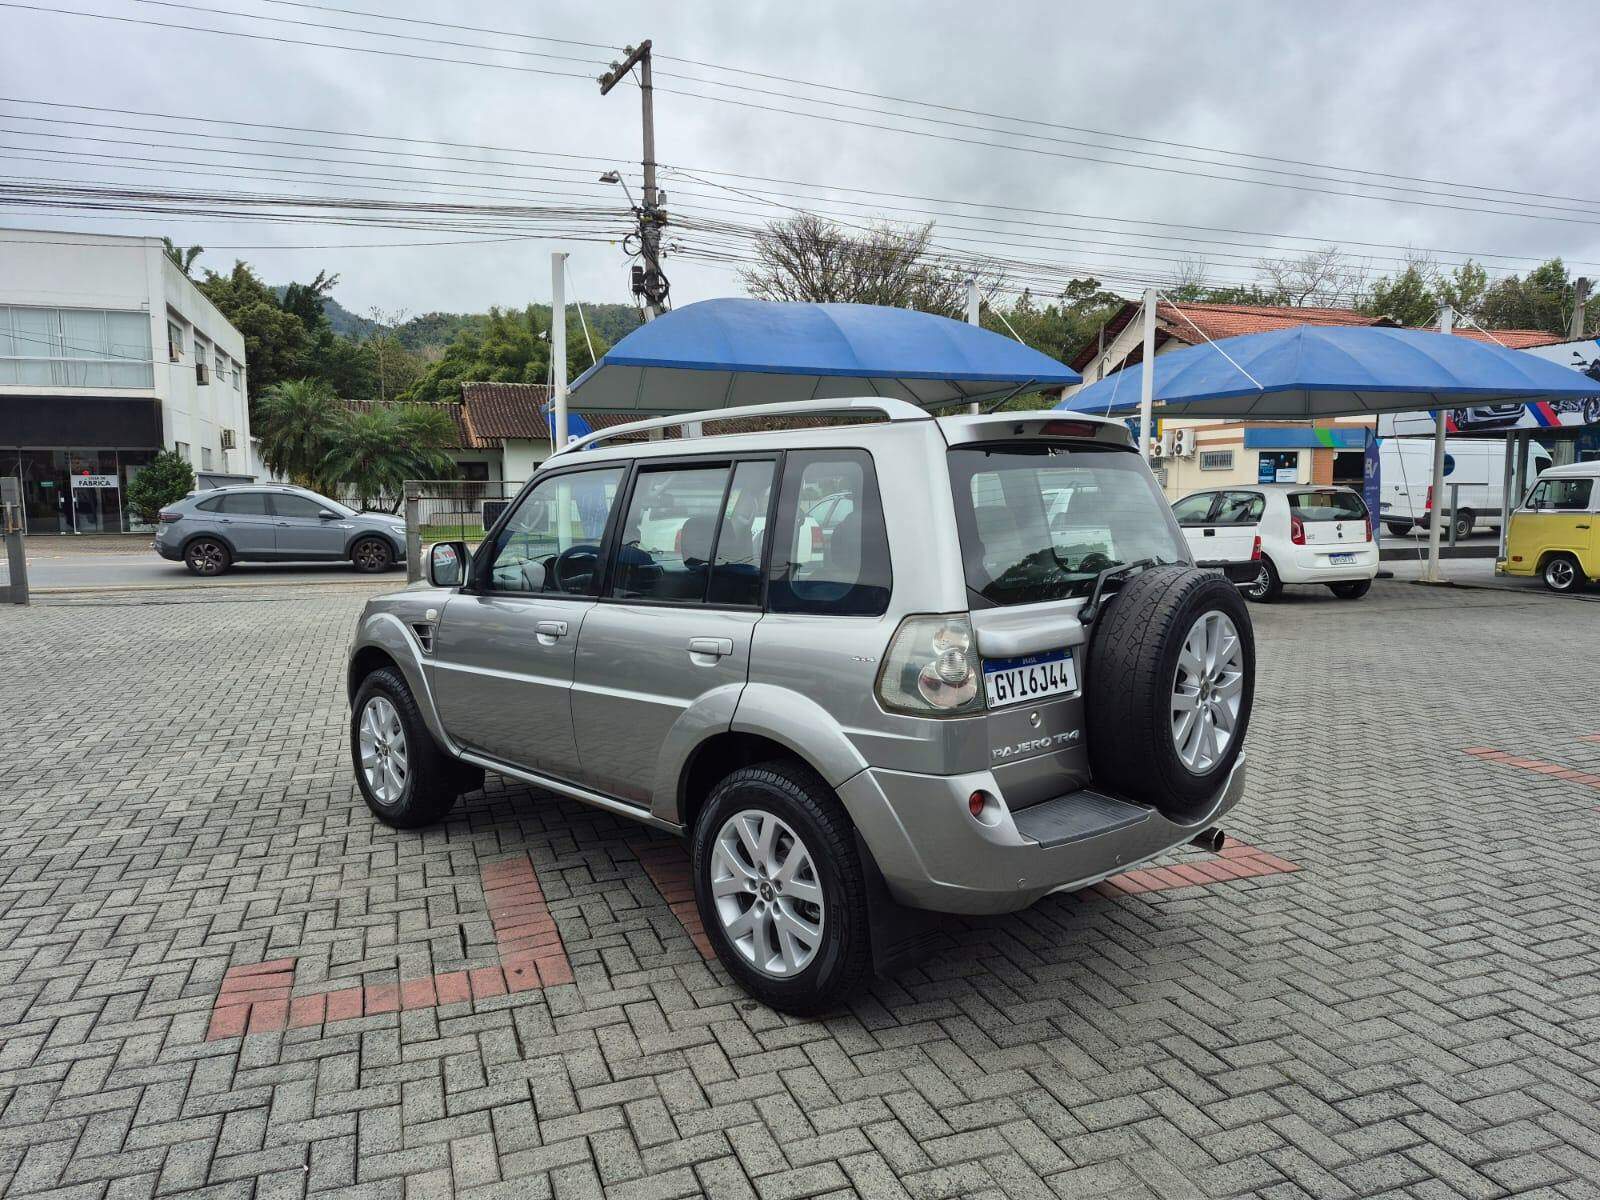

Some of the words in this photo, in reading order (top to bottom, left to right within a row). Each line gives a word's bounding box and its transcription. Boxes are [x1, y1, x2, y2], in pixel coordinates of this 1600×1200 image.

[994, 662, 1068, 701] GYI6J44
[992, 737, 1052, 759] PAJERO
[1053, 729, 1080, 744] TR4
